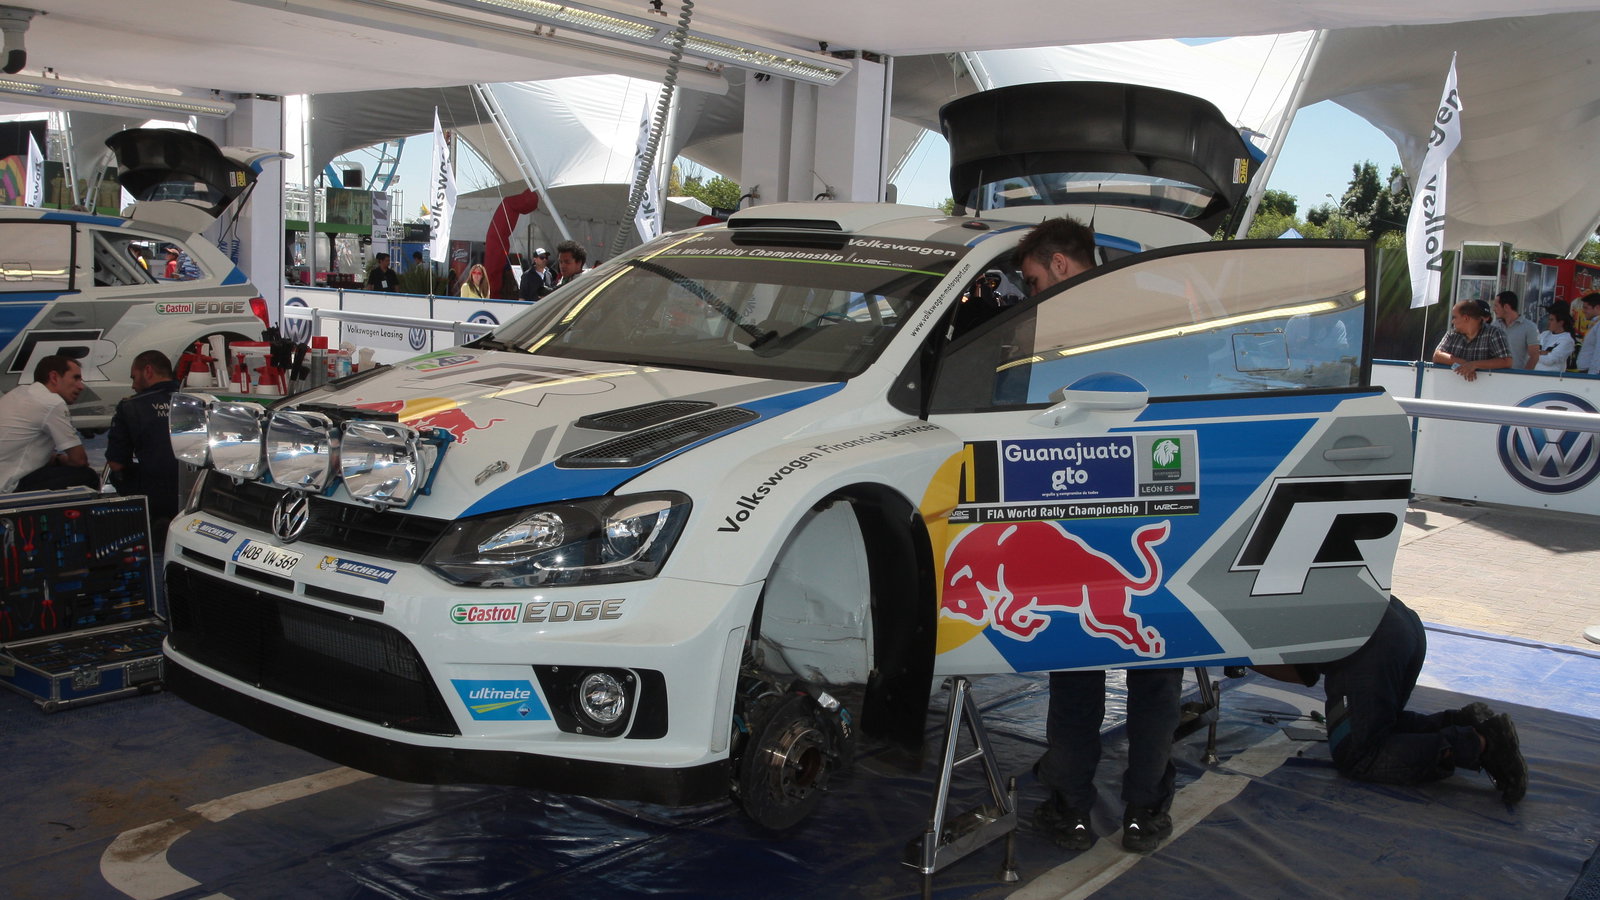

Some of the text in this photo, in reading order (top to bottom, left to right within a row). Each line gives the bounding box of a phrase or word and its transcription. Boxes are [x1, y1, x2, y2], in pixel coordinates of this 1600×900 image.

[714, 248, 748, 257] Rally
[748, 248, 844, 262] Championship
[848, 238, 957, 257] Volkswagen
[165, 301, 245, 314] Castrol EDGE
[910, 263, 971, 337] www.volkswagen-motorsport.com
[347, 325, 404, 341] Volkswagen Leasing
[1005, 442, 1132, 466] Guanajuato
[717, 424, 940, 535] Volkswagen Financial Services
[1051, 467, 1088, 491] gto
[1141, 484, 1163, 493] LEÓN
[987, 509, 1005, 519] FIA
[1007, 508, 1037, 519] World
[1040, 506, 1066, 518] Rally
[1069, 503, 1139, 517] Championship
[201, 523, 232, 540] MICHELIN
[240, 544, 264, 560] WOB
[275, 554, 299, 571] 369
[340, 562, 392, 581] MICHELIN
[467, 599, 626, 623] Castrol EDGE
[469, 687, 531, 700] ultimate
